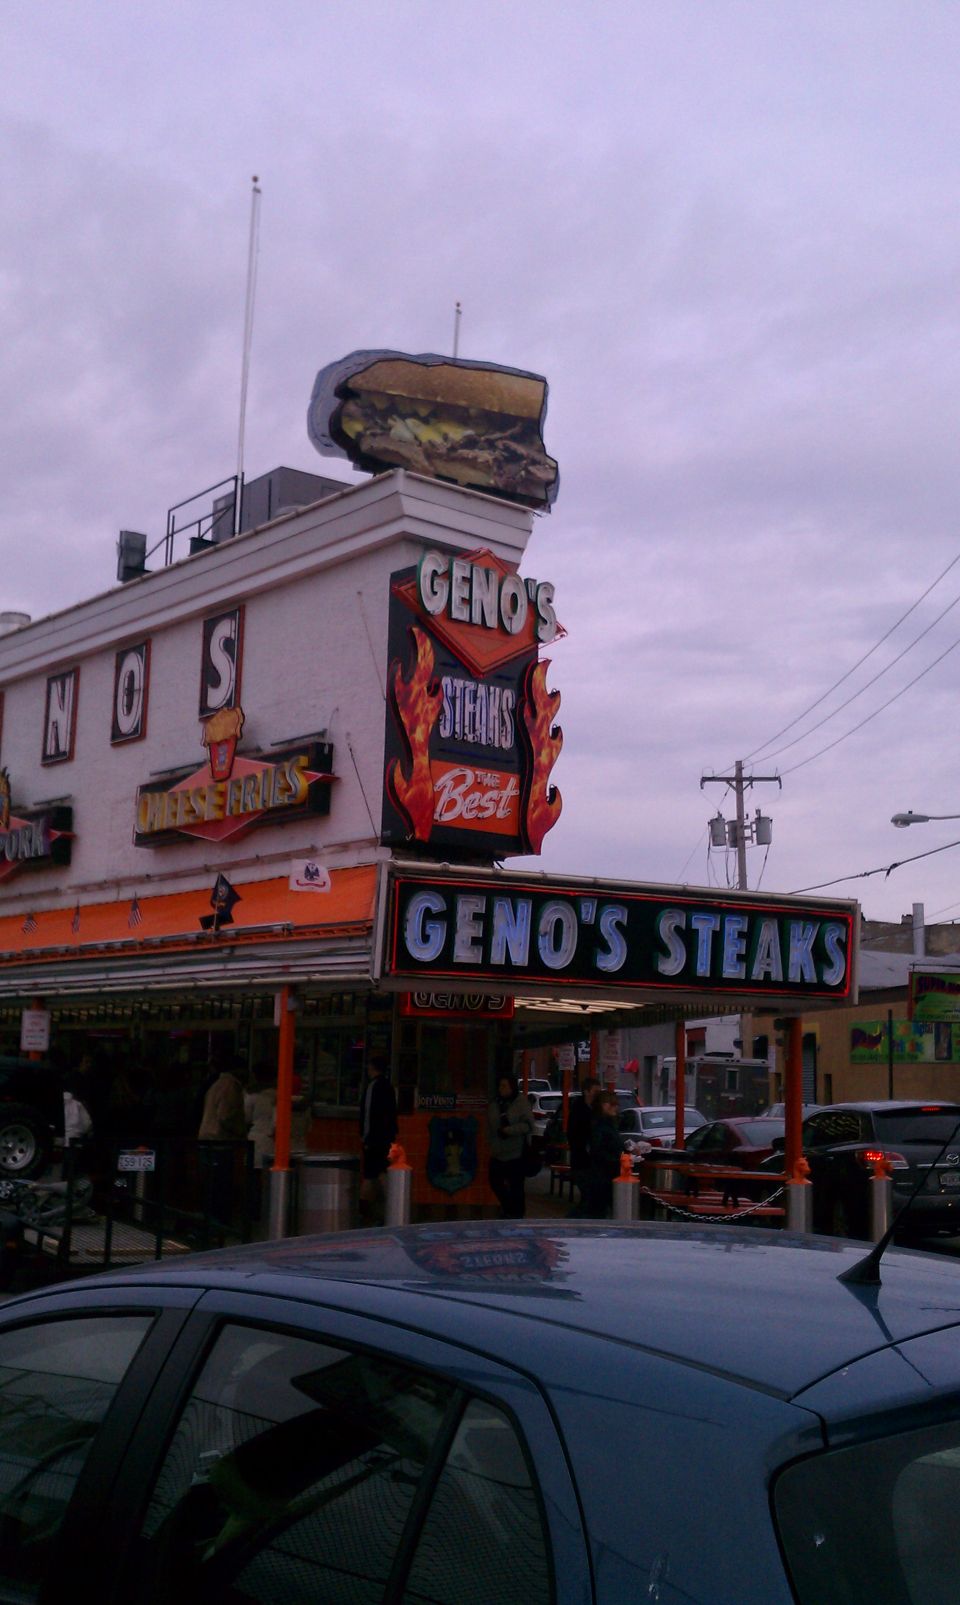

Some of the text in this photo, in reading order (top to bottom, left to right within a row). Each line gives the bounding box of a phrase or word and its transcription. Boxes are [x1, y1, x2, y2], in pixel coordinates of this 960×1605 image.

[416, 550, 558, 644] GENO'S
[439, 675, 516, 751] STEAKS
[136, 755, 309, 832] CHEESE FRIES
[433, 767, 520, 822] Best
[475, 769, 501, 789] THE
[403, 890, 847, 987] GENO'S STEAKS
